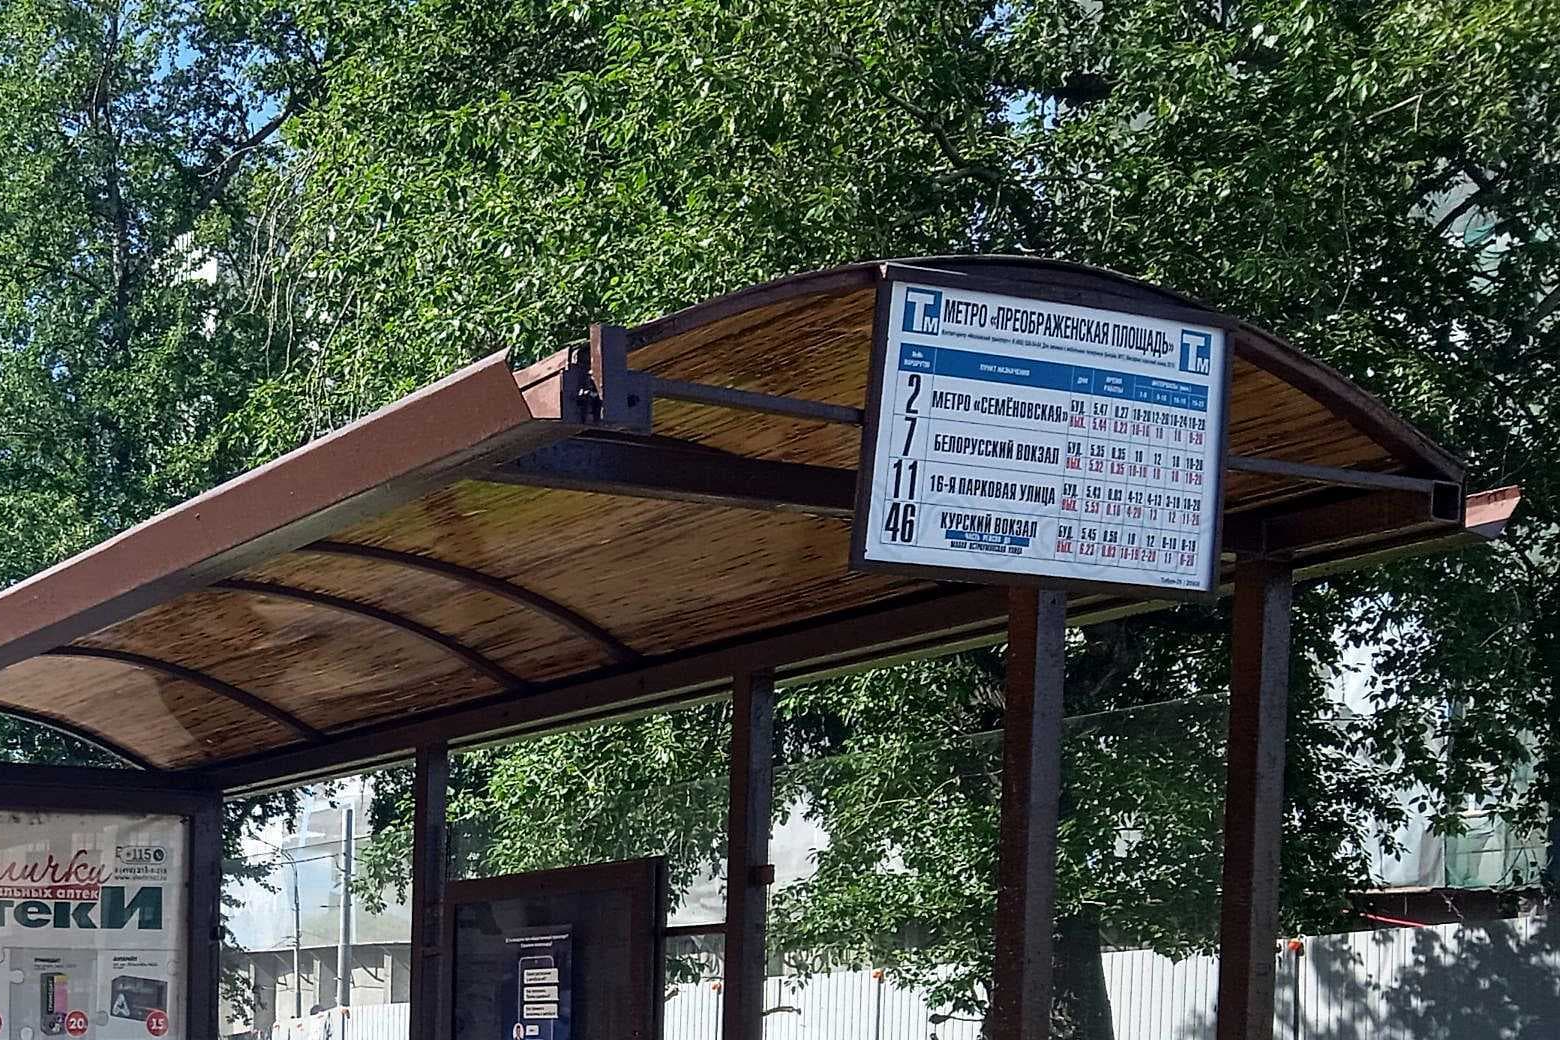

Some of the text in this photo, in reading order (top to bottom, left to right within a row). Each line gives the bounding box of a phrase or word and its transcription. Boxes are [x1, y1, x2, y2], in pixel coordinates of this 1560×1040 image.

[943, 299, 1174, 358] МЕТРО «ПРЕОБРАЖЕНСКАЯ ПЛОЩАДЬ»
[906, 374, 921, 414] 2
[932, 391, 1068, 423] МЕТРО «СЕМЁНОВСКАЯ»
[903, 416, 917, 456] 7
[934, 433, 1060, 464] БЕЛОРУССКИЙ ВОКЗАЛ
[893, 459, 918, 500] 11
[930, 474, 1056, 507] 16-Я ПАРКОВАЯ УЛИЦА
[885, 502, 916, 543] 46
[941, 511, 1038, 538] КУРСКИЙ ВОКЗАЛ
[56, 888, 99, 900] аптек
